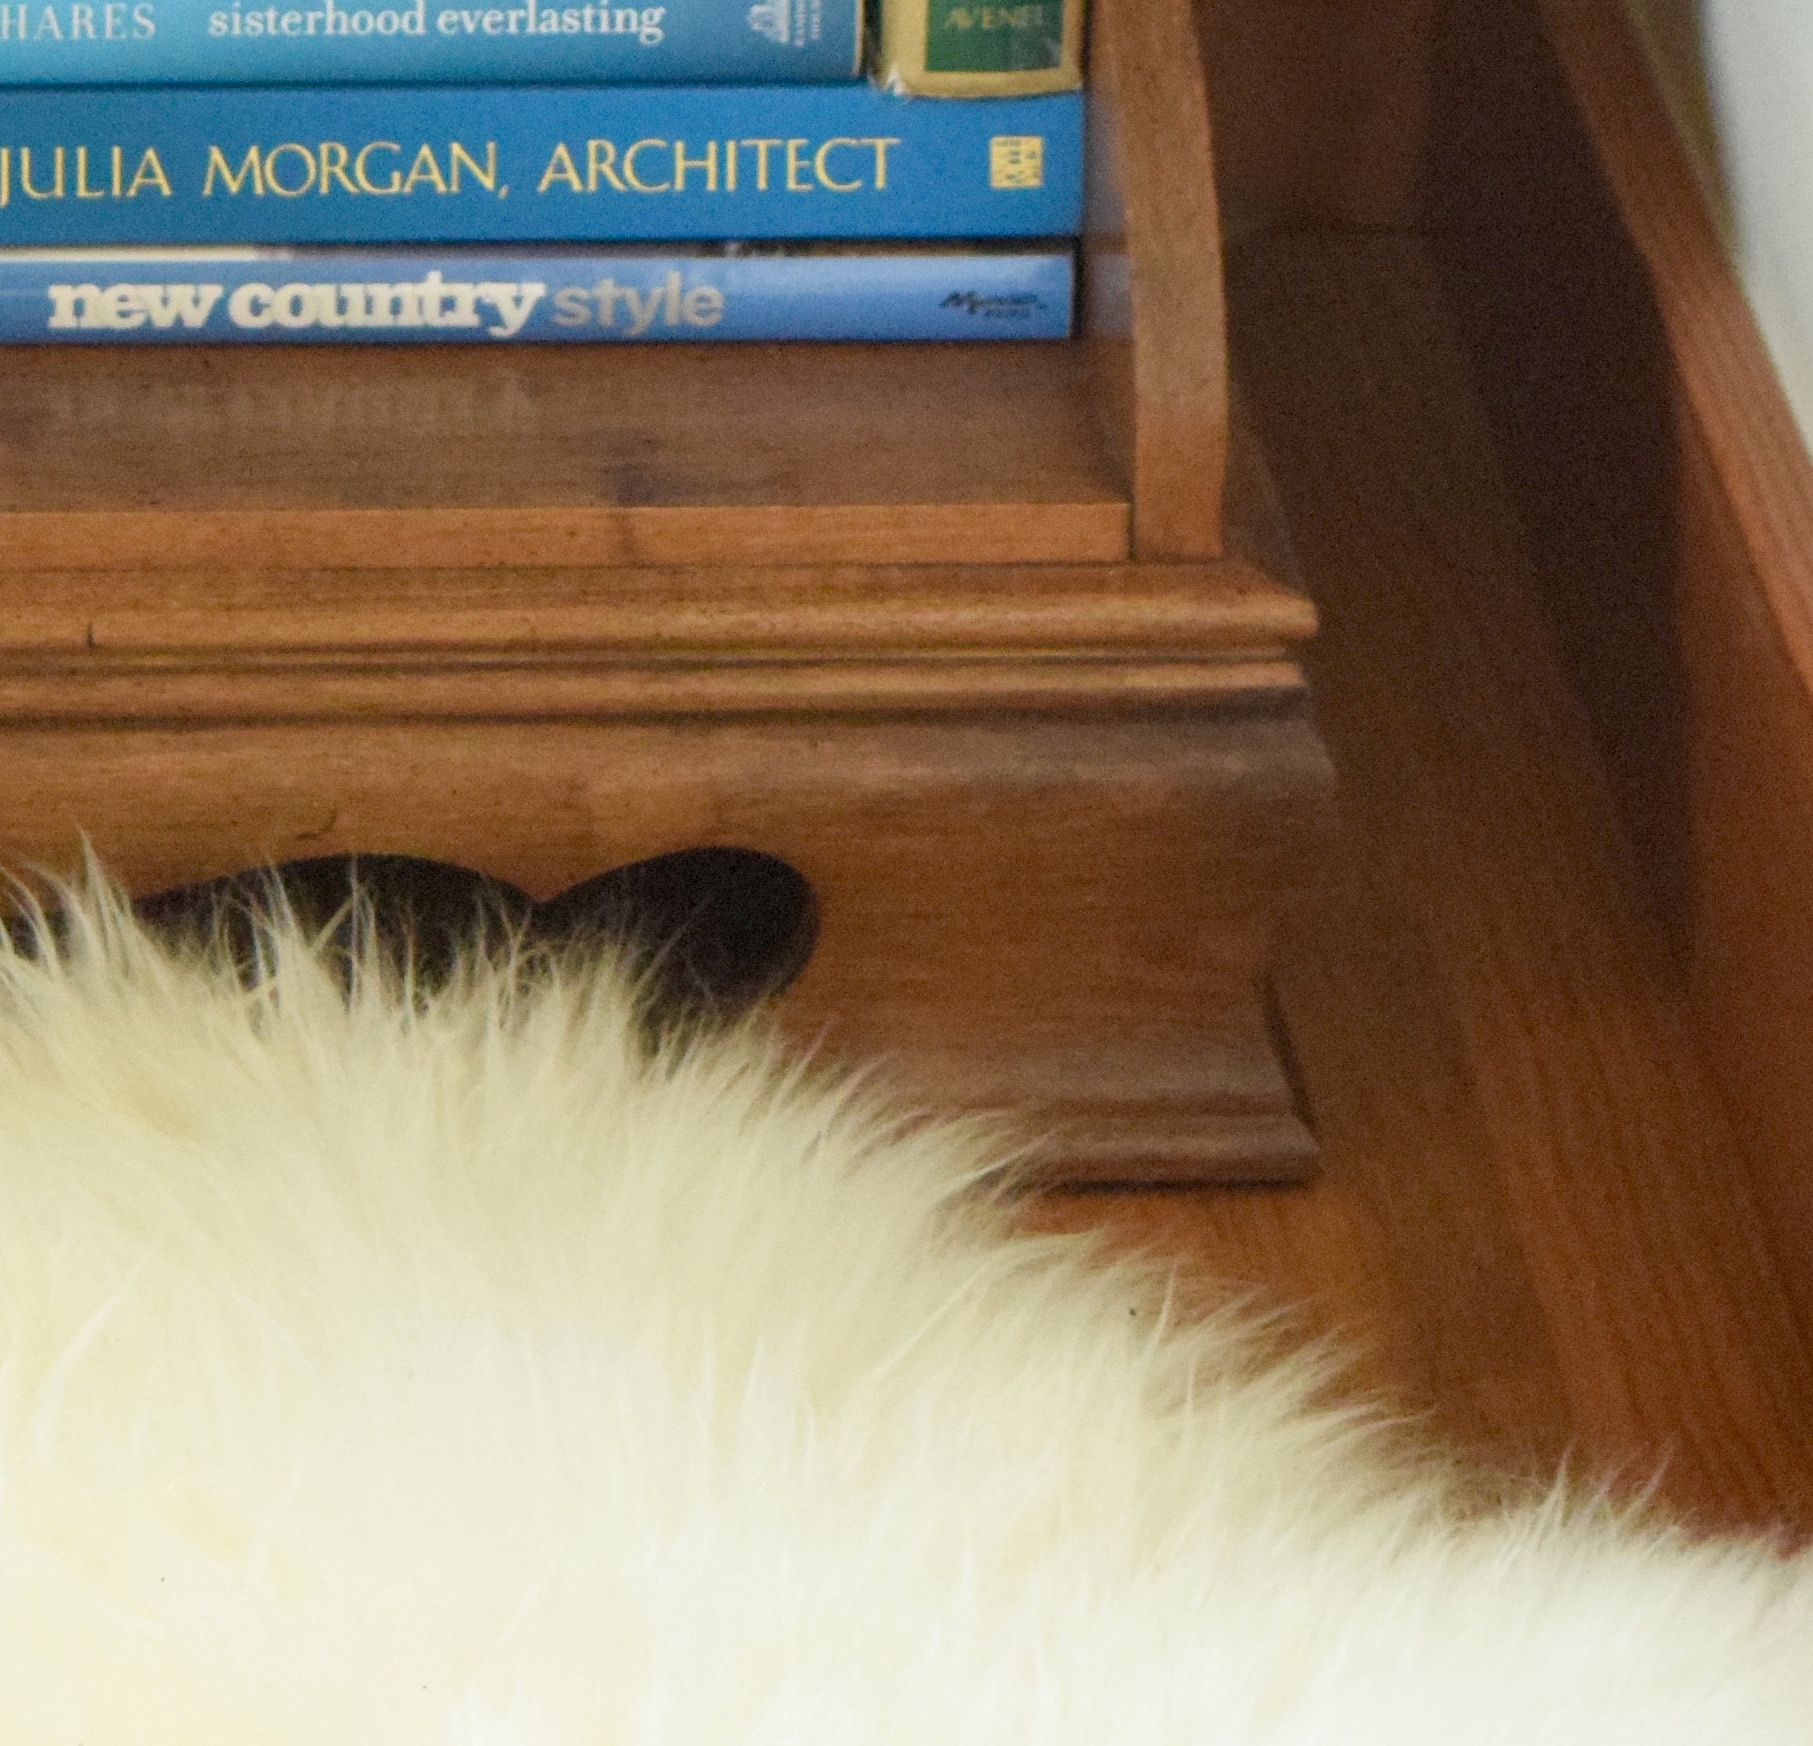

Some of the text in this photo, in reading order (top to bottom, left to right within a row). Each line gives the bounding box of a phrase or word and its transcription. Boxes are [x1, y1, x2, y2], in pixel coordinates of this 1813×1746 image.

[435, 1, 667, 45] everlasting
[202, 139, 512, 200] MORGAN,
[536, 136, 901, 194] ARCHITECT
[47, 269, 725, 339] new country style
